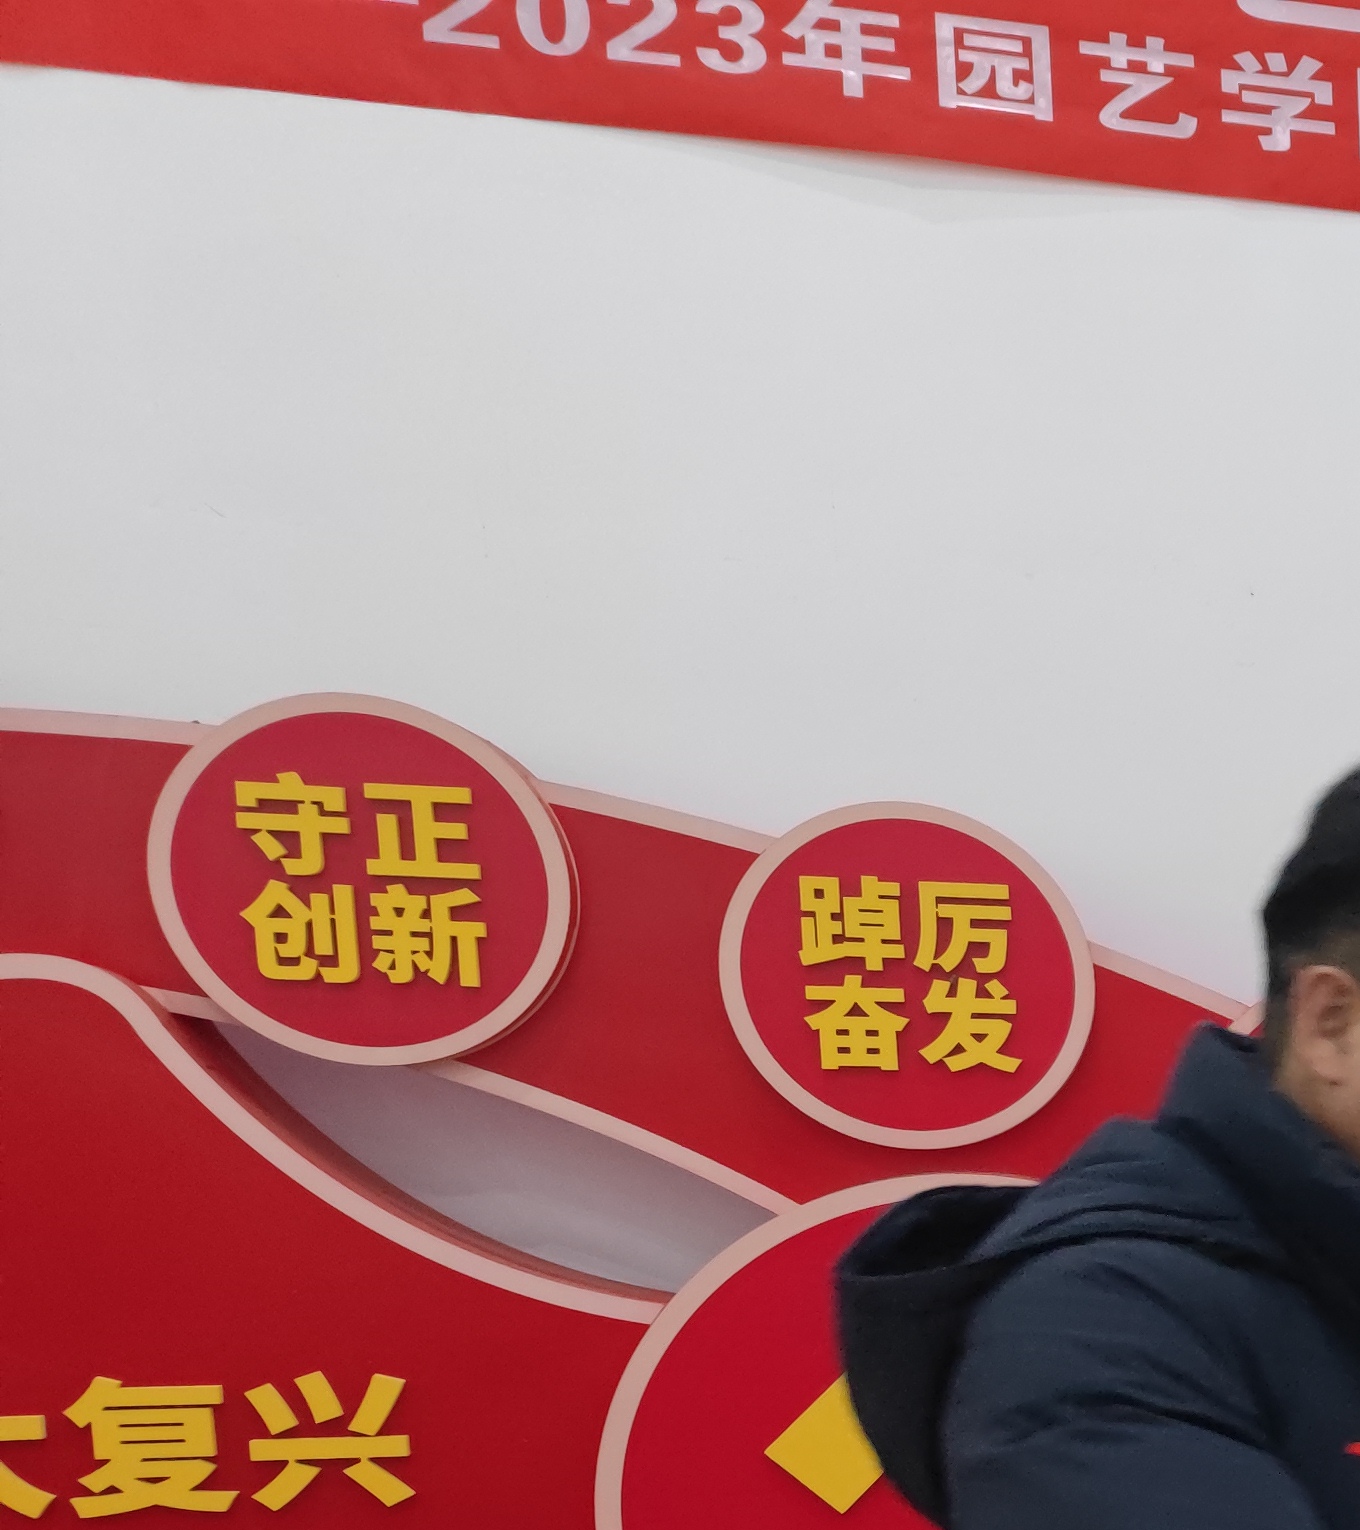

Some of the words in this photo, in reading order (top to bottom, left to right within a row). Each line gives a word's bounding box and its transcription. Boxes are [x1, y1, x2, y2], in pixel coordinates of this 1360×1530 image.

[235, 772, 482, 880] 守正
[240, 880, 487, 988] 创新
[799, 876, 1012, 973] 踔厉
[805, 976, 1022, 1073] 奋发
